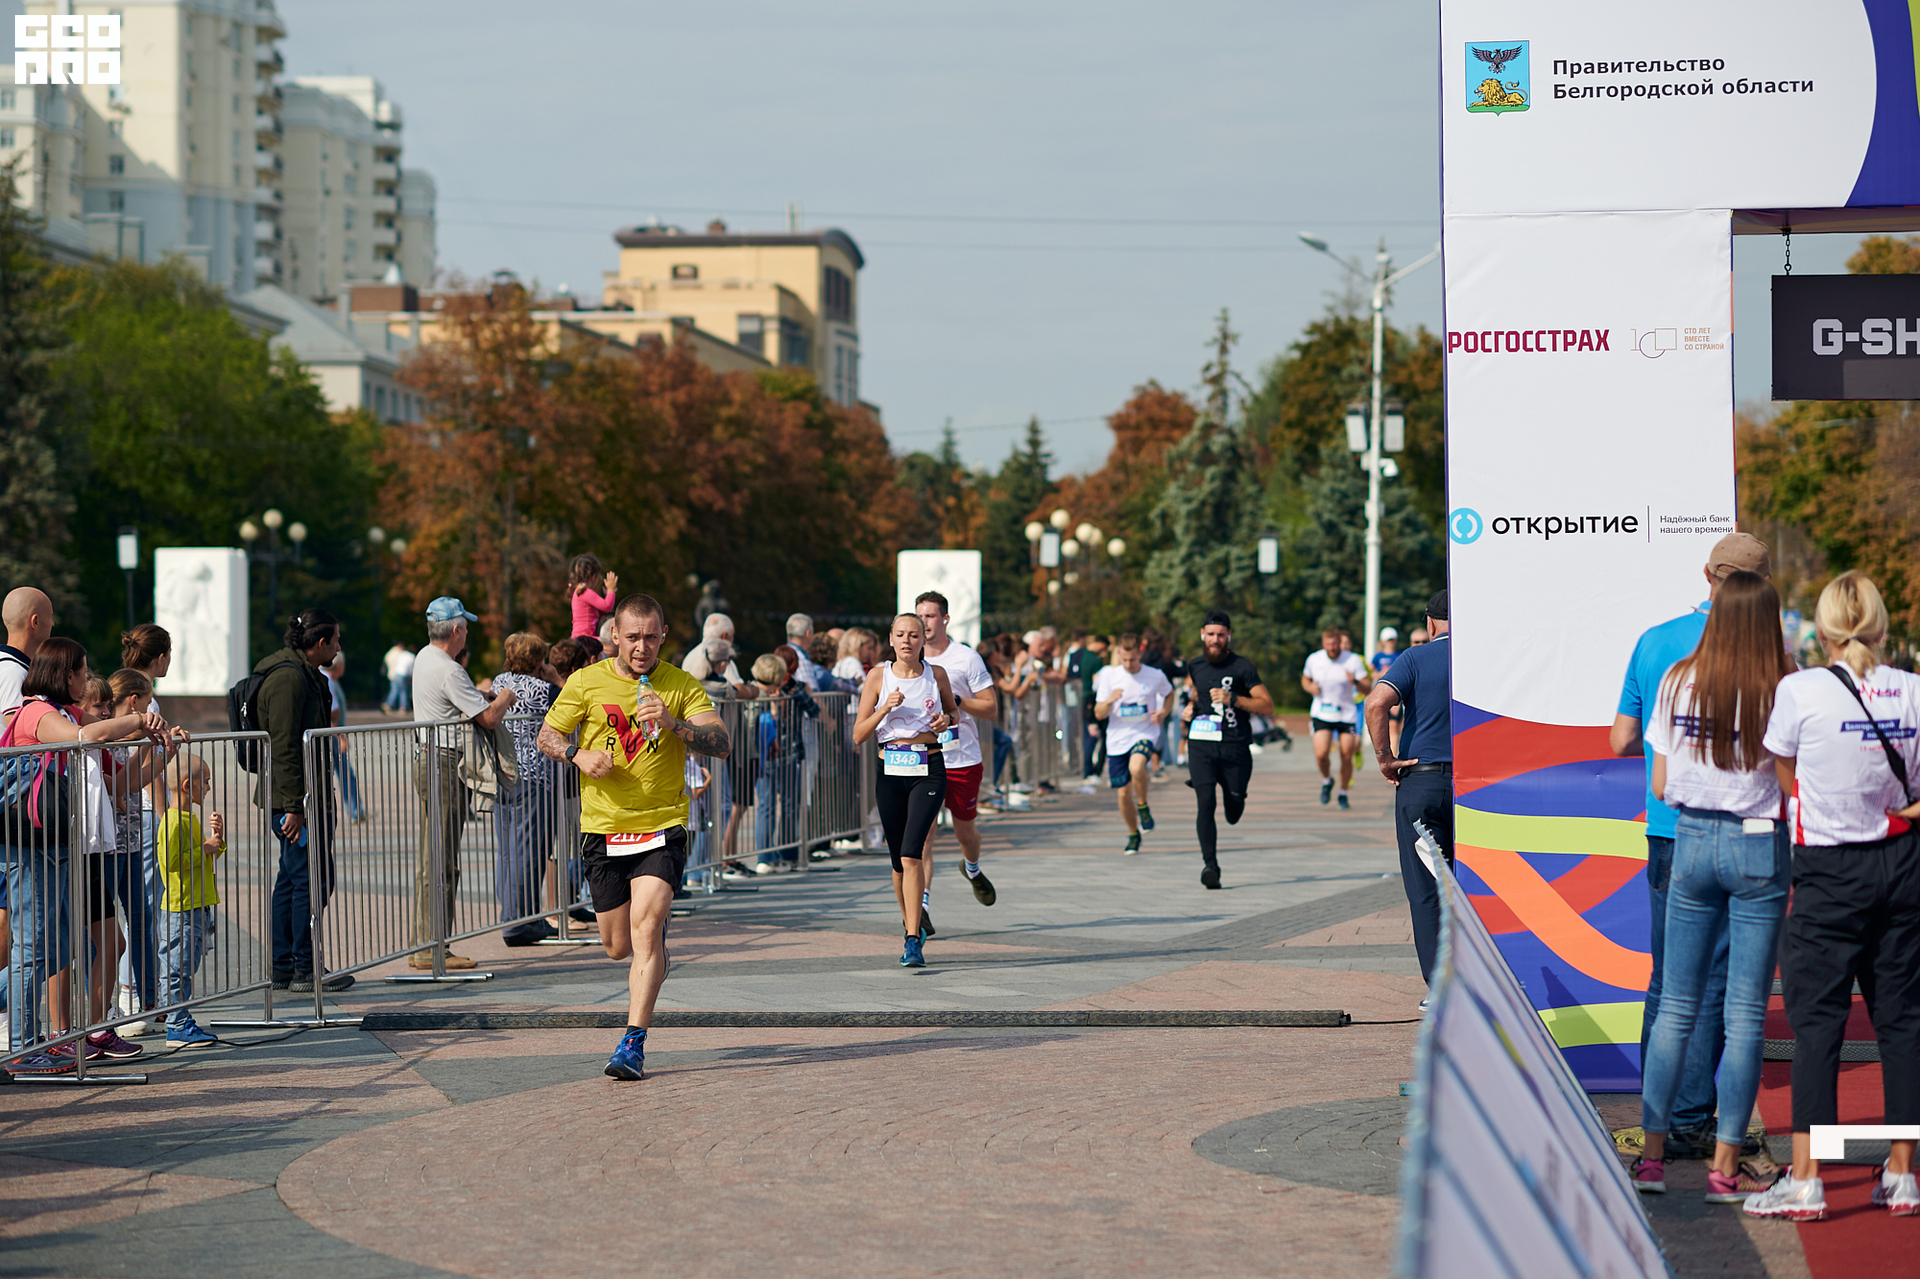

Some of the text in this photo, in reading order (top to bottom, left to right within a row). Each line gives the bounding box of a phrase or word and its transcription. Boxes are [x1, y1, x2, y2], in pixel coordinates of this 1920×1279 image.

[1552, 57, 1725, 77] Правительство
[1552, 78, 1815, 101] Белгородской области
[1448, 329, 1610, 354] РОСГОССТРАХ
[1812, 318, 1920, 356] G-SH
[1684, 342, 1725, 351] СО СТРАНОЙ
[1491, 513, 1640, 541] открытие
[1659, 514, 1731, 524] Надёжный банк
[1659, 526, 1734, 535] нашего времени
[605, 736, 660, 754] RUN
[890, 753, 917, 765] 1348
[610, 833, 643, 843] 2117
